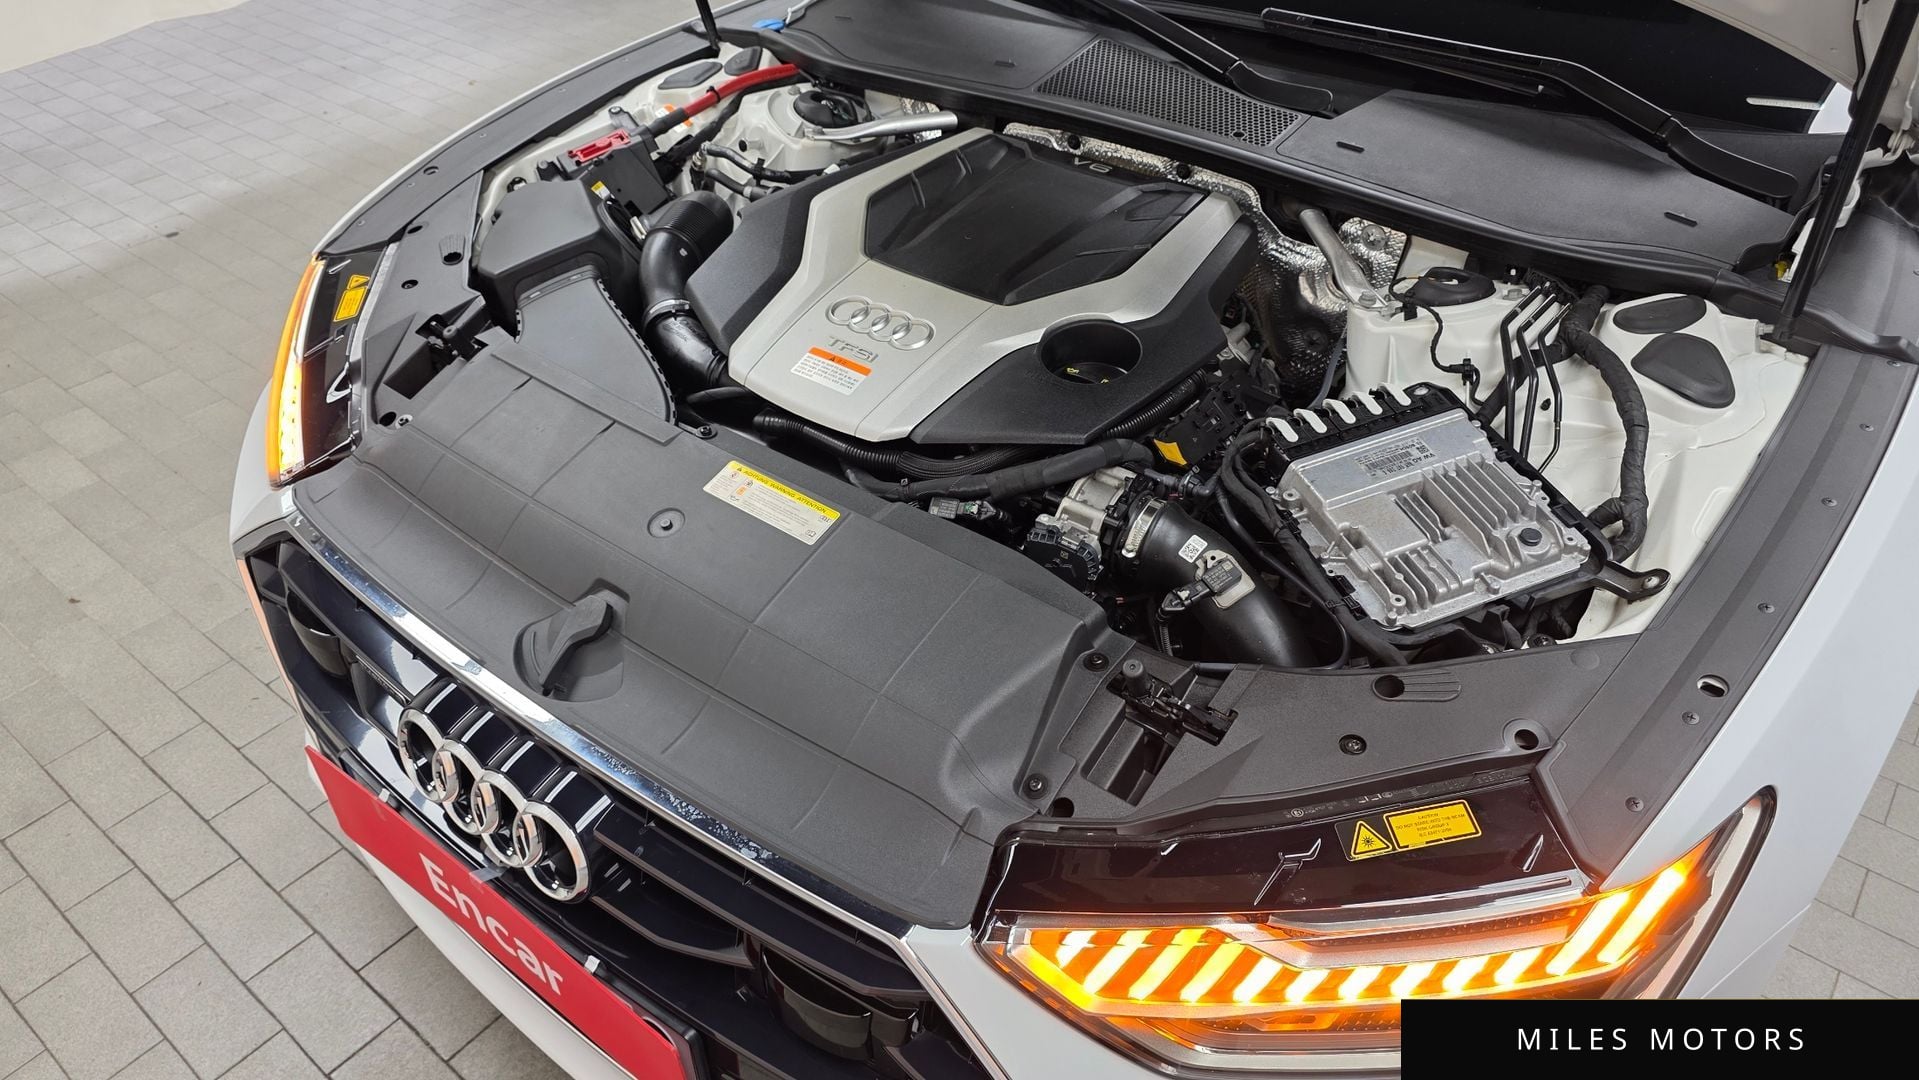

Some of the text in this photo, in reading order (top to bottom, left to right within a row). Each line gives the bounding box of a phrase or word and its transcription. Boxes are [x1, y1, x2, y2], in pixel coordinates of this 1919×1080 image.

[1074, 156, 1113, 173] V6
[828, 335, 879, 363] TFSI
[743, 469, 769, 485] ACHTUNG
[770, 482, 796, 499] WARNING
[796, 495, 827, 514] ATTENTION
[418, 852, 564, 996] Encar
